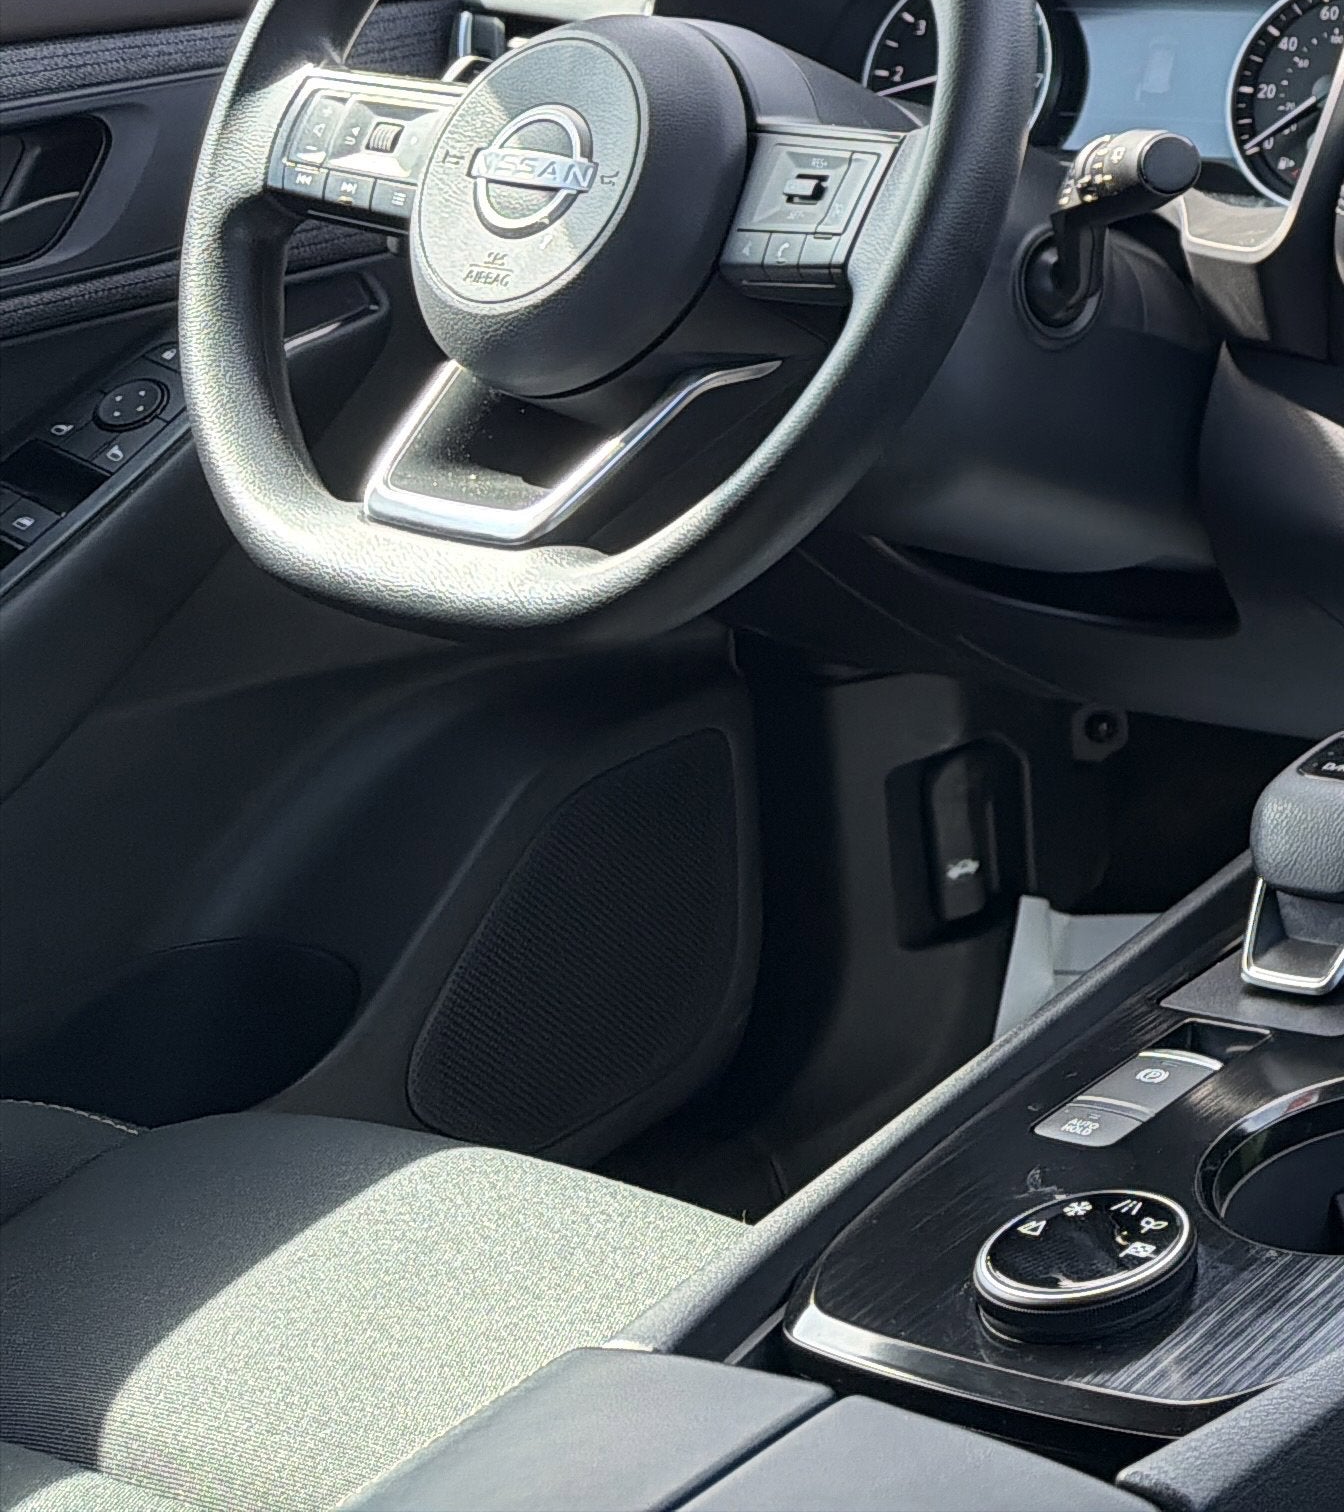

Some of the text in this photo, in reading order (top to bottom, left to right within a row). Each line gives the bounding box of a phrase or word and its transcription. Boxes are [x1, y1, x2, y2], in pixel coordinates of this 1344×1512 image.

[1319, 5, 1339, 21] 60
[915, 19, 927, 36] 3
[1278, 36, 1298, 52] 40
[892, 65, 904, 82] 2
[1257, 83, 1277, 99] 20
[1060, 1124, 1093, 1136] HOLD
[1067, 1117, 1100, 1130] AUTO
